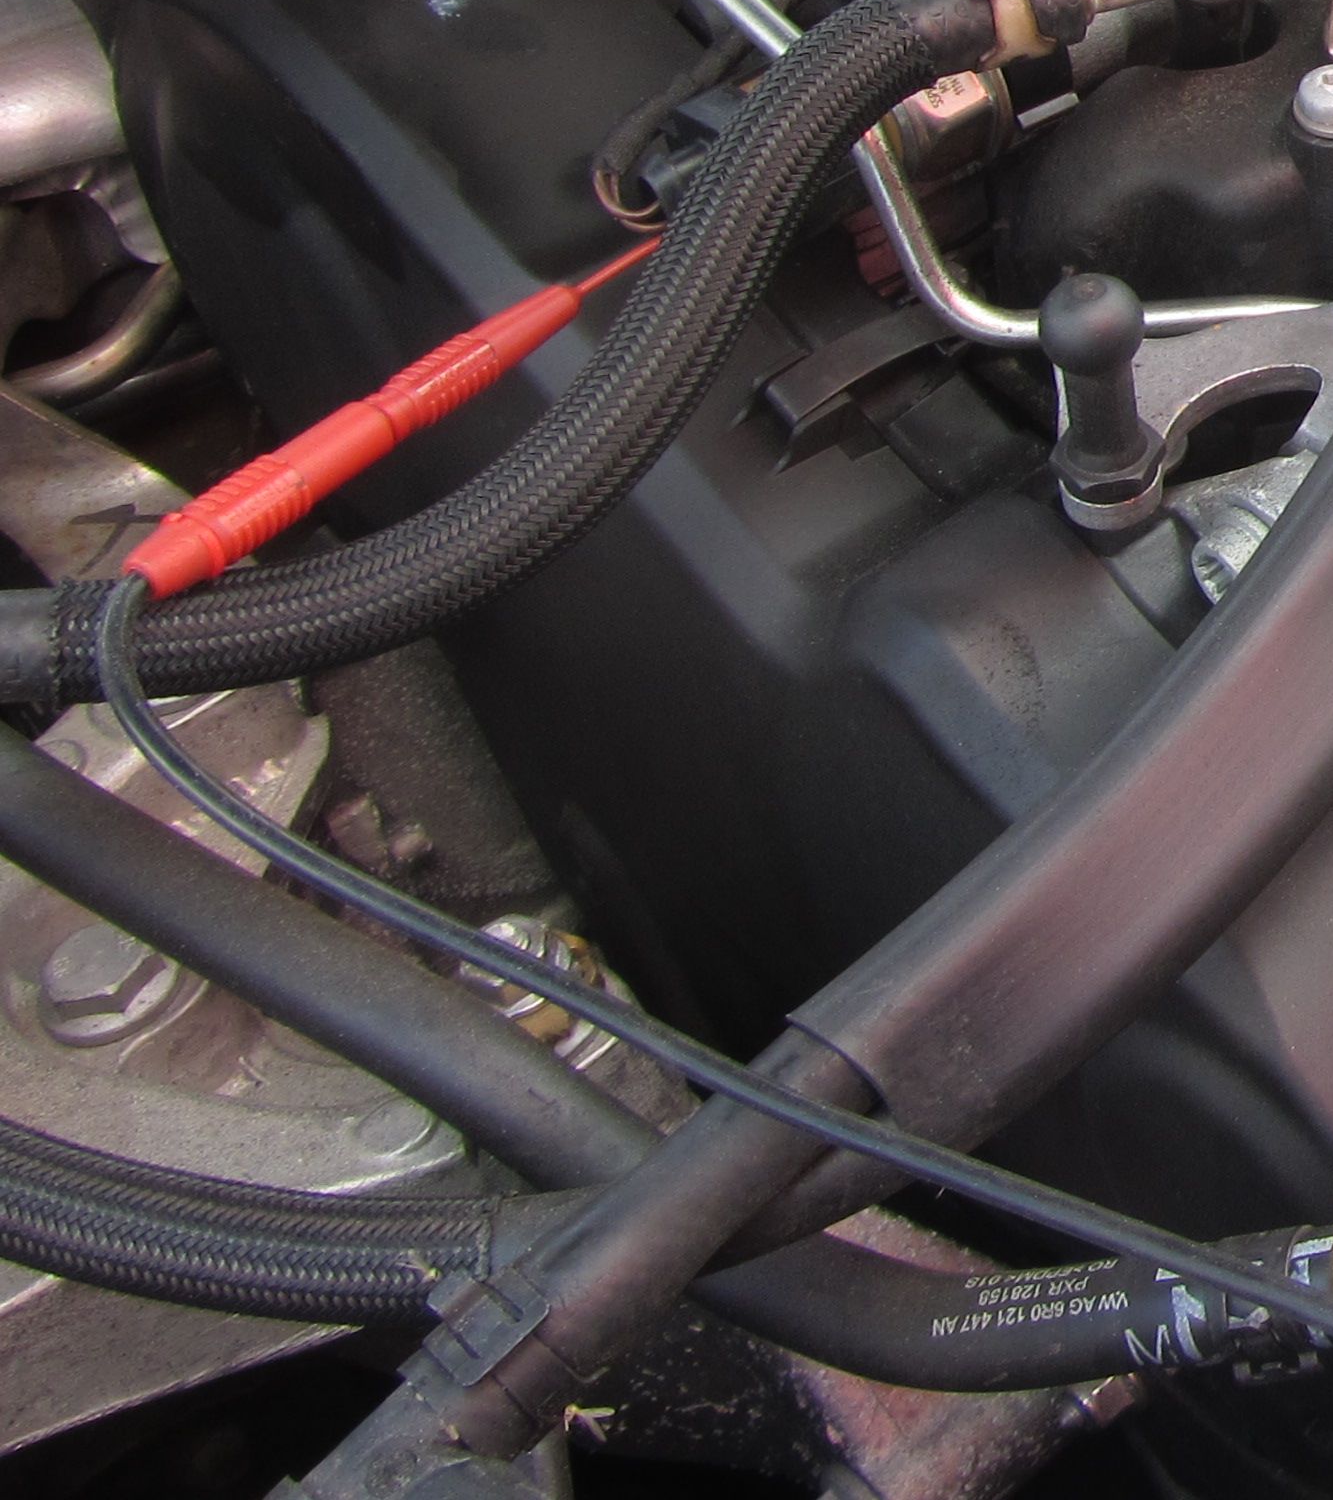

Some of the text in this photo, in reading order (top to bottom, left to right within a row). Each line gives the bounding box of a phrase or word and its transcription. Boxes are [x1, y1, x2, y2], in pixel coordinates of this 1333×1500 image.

[1046, 1276, 1090, 1294] PXR
[995, 1305, 1026, 1325] 121
[1029, 1299, 1065, 1320] 6R0
[929, 1315, 959, 1336] AN
[958, 1311, 993, 1332] 447
